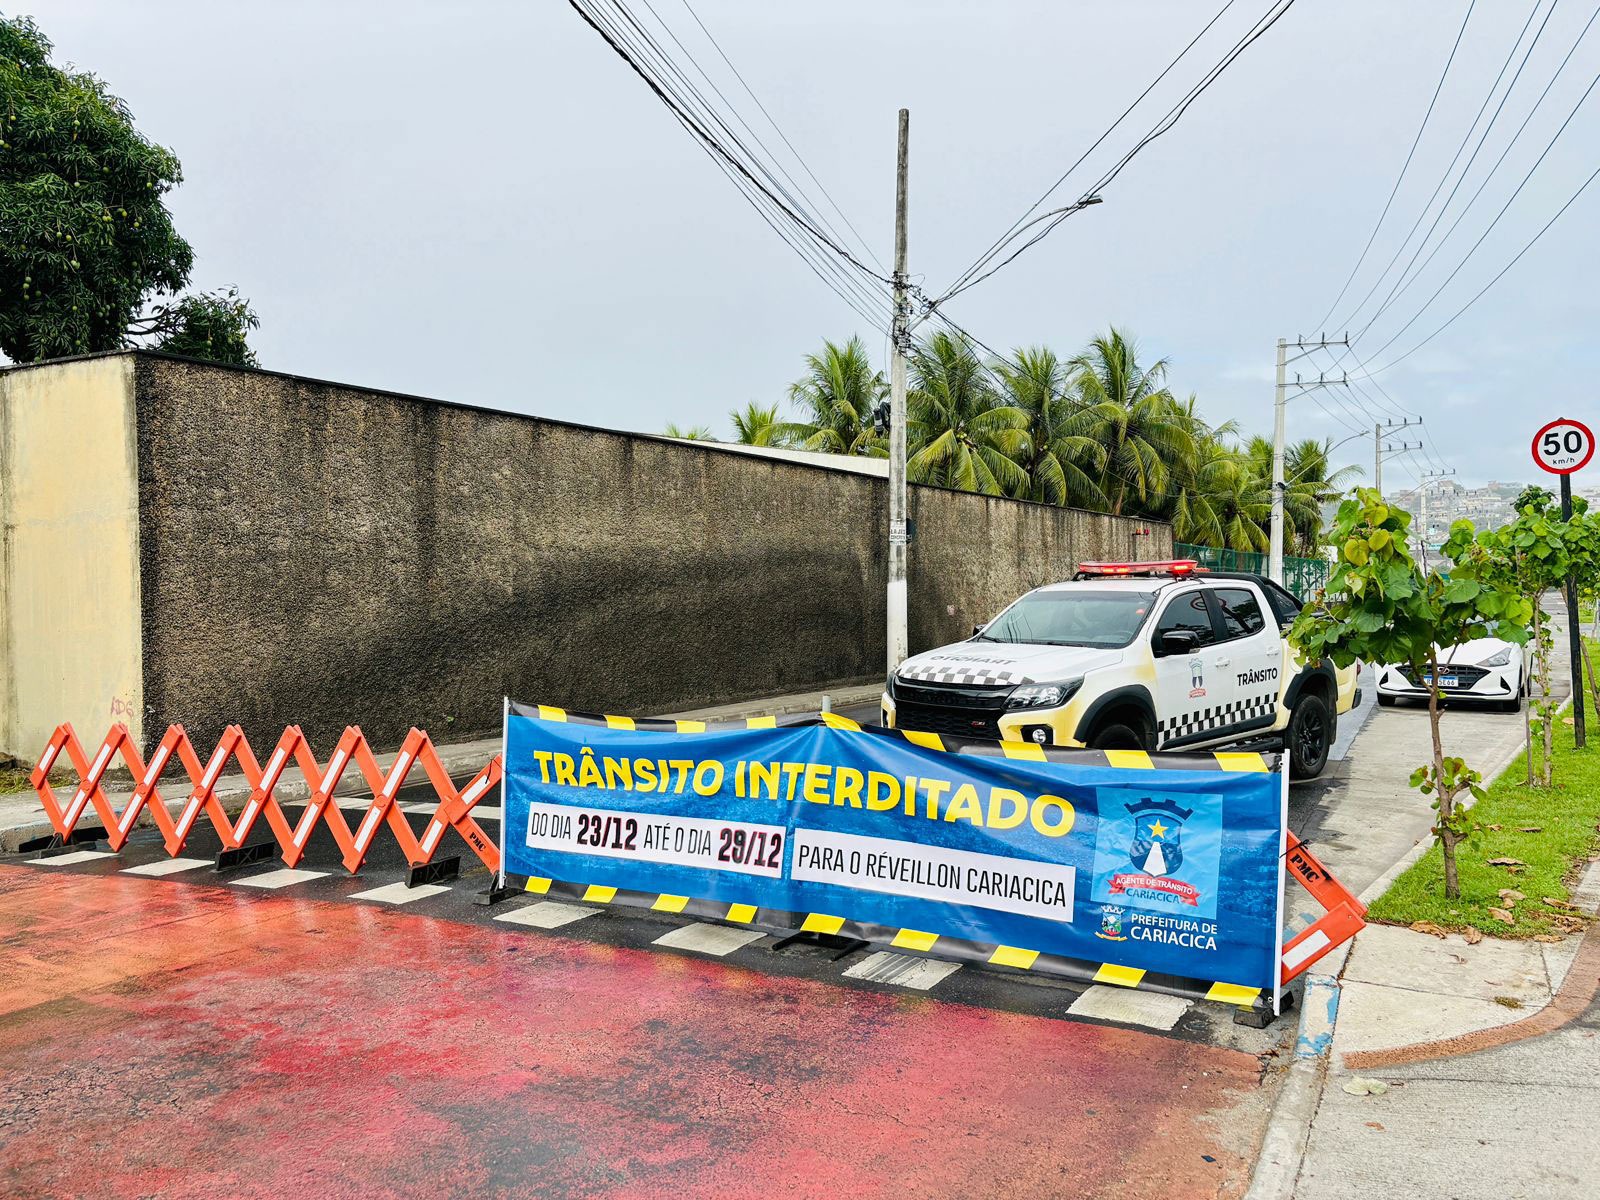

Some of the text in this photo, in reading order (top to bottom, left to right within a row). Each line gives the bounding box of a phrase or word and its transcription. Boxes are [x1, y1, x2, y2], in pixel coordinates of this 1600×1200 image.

[1543, 430, 1582, 456] 50
[1552, 457, 1575, 465] km/h
[1237, 667, 1278, 687] TRÂNSITO
[533, 747, 1076, 838] TRÂNSITO INTERDITADO
[469, 831, 487, 852] PMC
[531, 812, 782, 869] DO DIA 23/12 ATÉ O DIA 29/12
[798, 845, 1066, 908] PARA O RÉVEILLON CARIACICA
[1290, 853, 1320, 883] PMC
[1115, 877, 1193, 895] AGENTE DE TRÂNSITO
[1126, 888, 1180, 903] CARIACICA
[1131, 913, 1218, 935] PREFEITURA DE
[1130, 926, 1217, 951] CARIACICA
